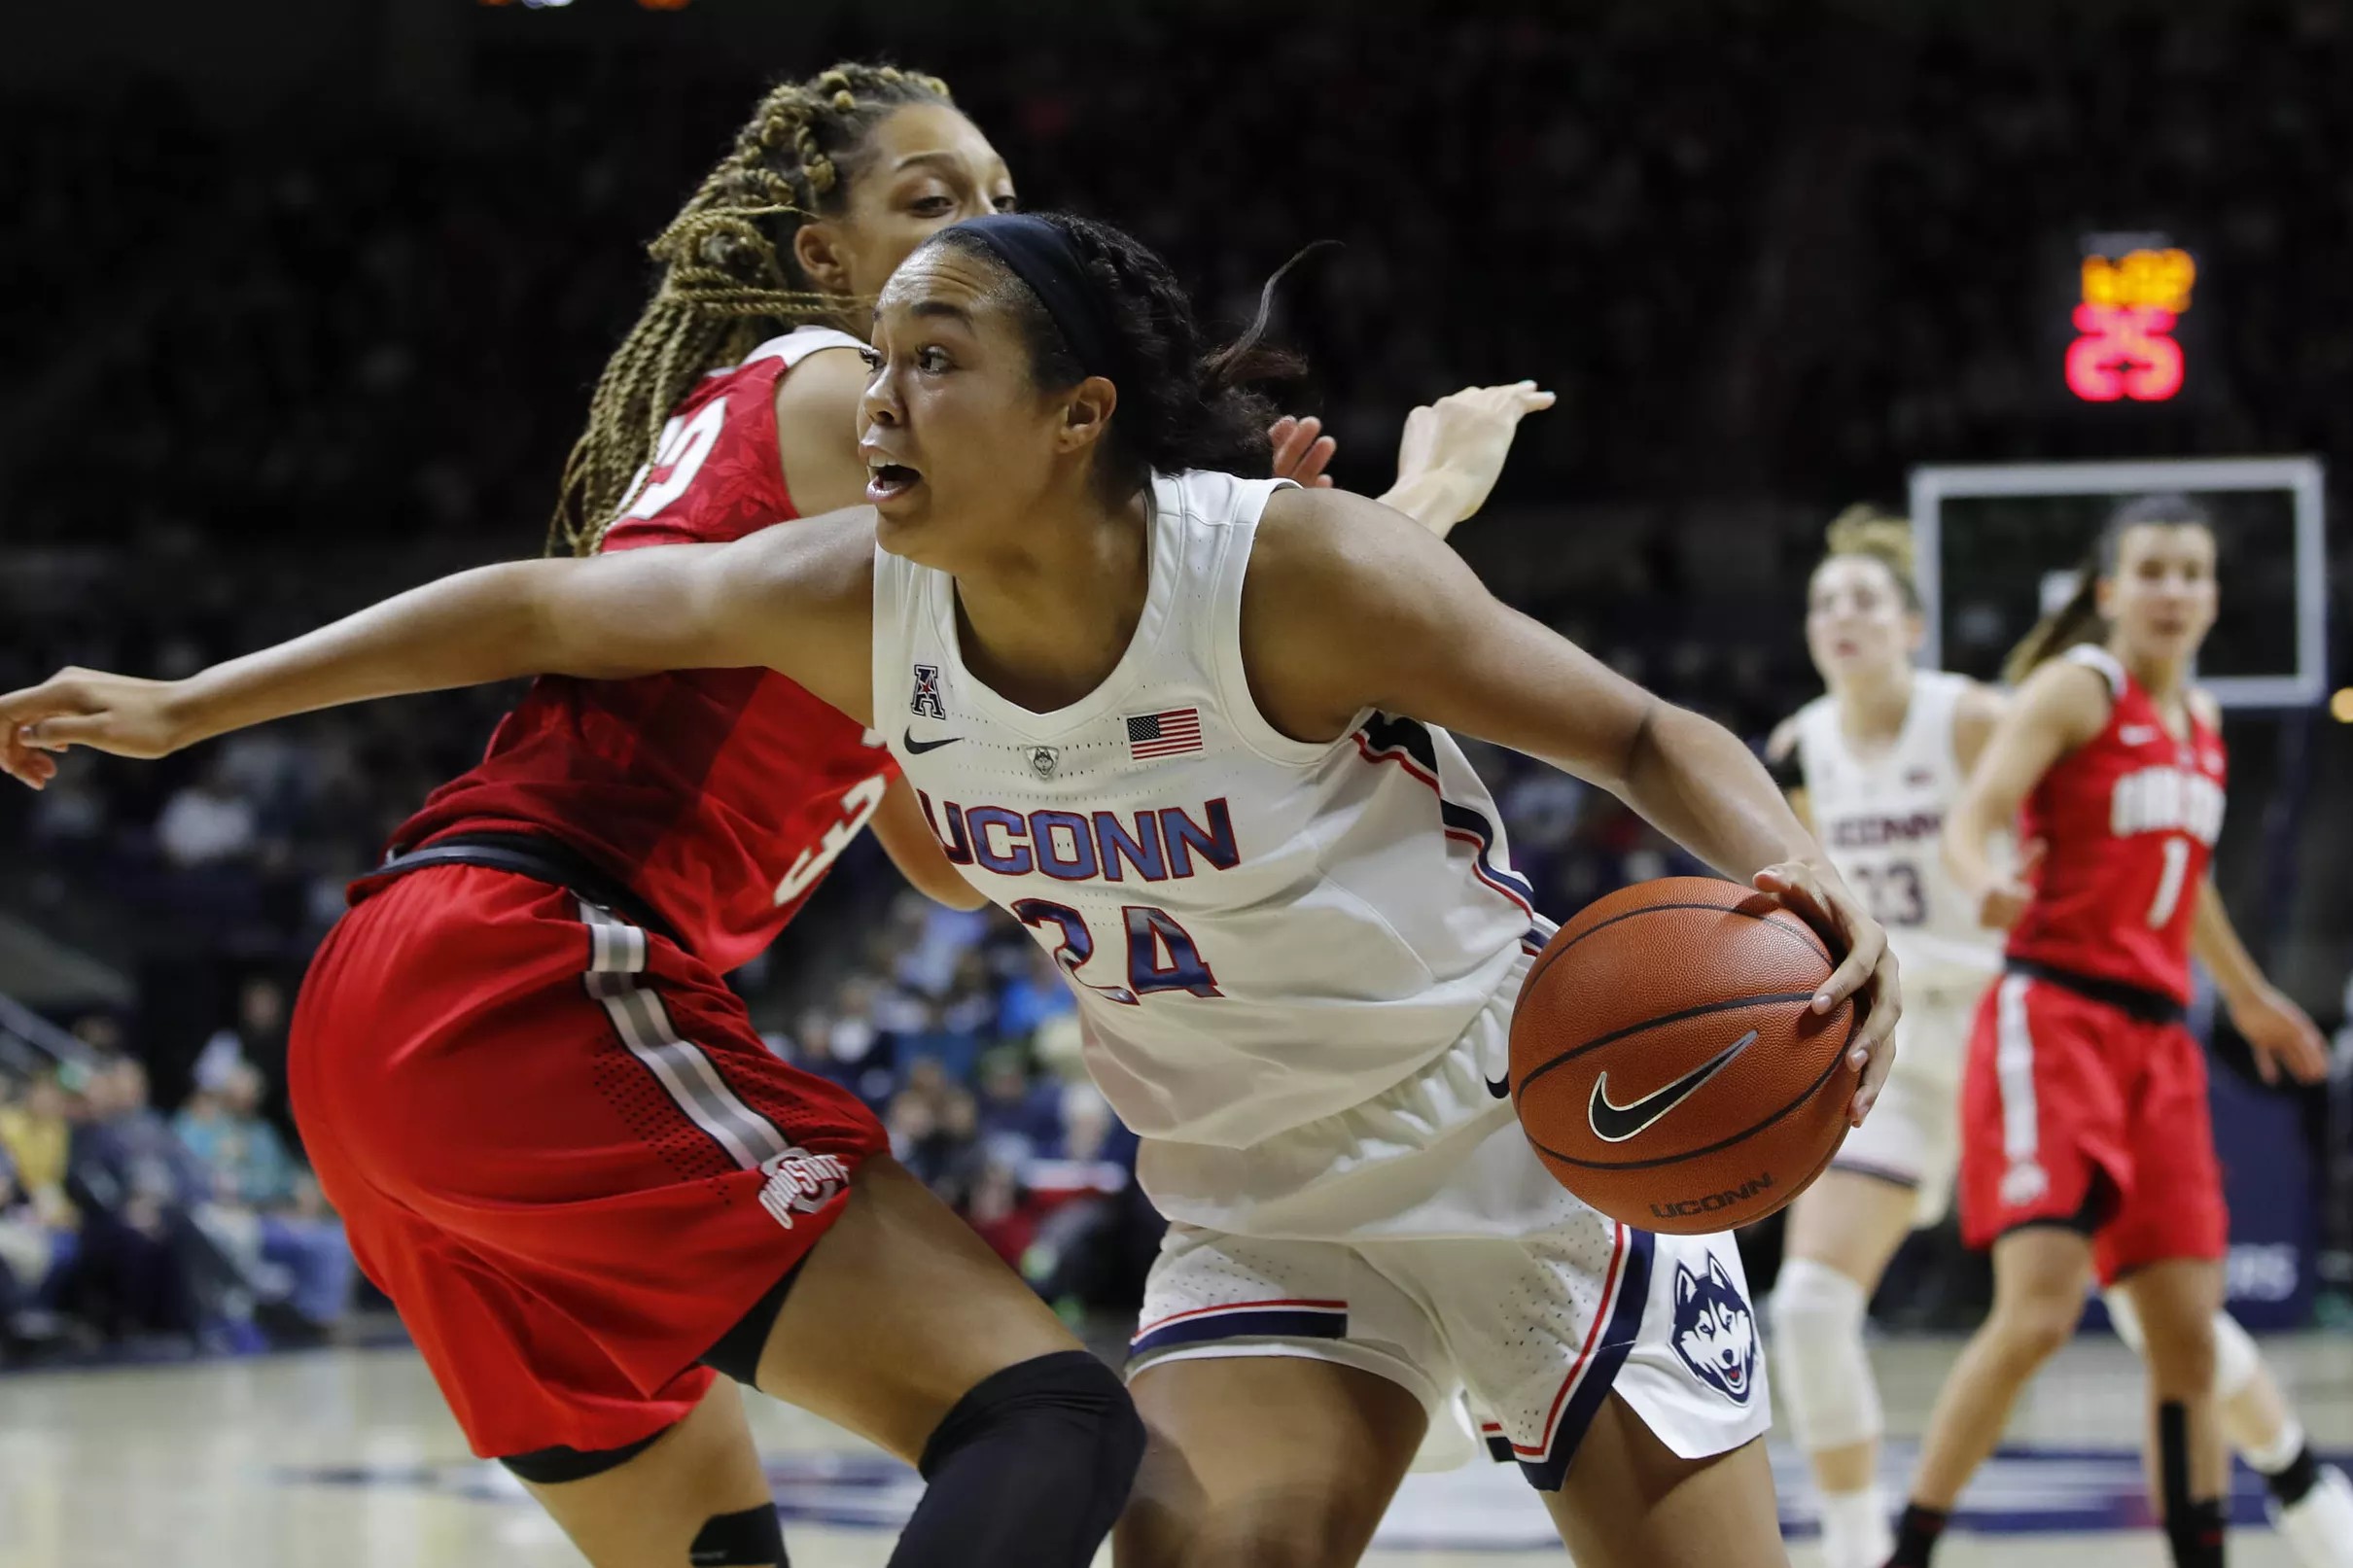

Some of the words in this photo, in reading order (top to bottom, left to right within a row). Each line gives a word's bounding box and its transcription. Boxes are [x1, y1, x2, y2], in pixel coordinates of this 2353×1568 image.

[916, 788, 1240, 882] UCONN
[2147, 837, 2191, 930] 1
[1010, 898, 1225, 1006] 24
[1650, 1171, 1774, 1219] UCONN
